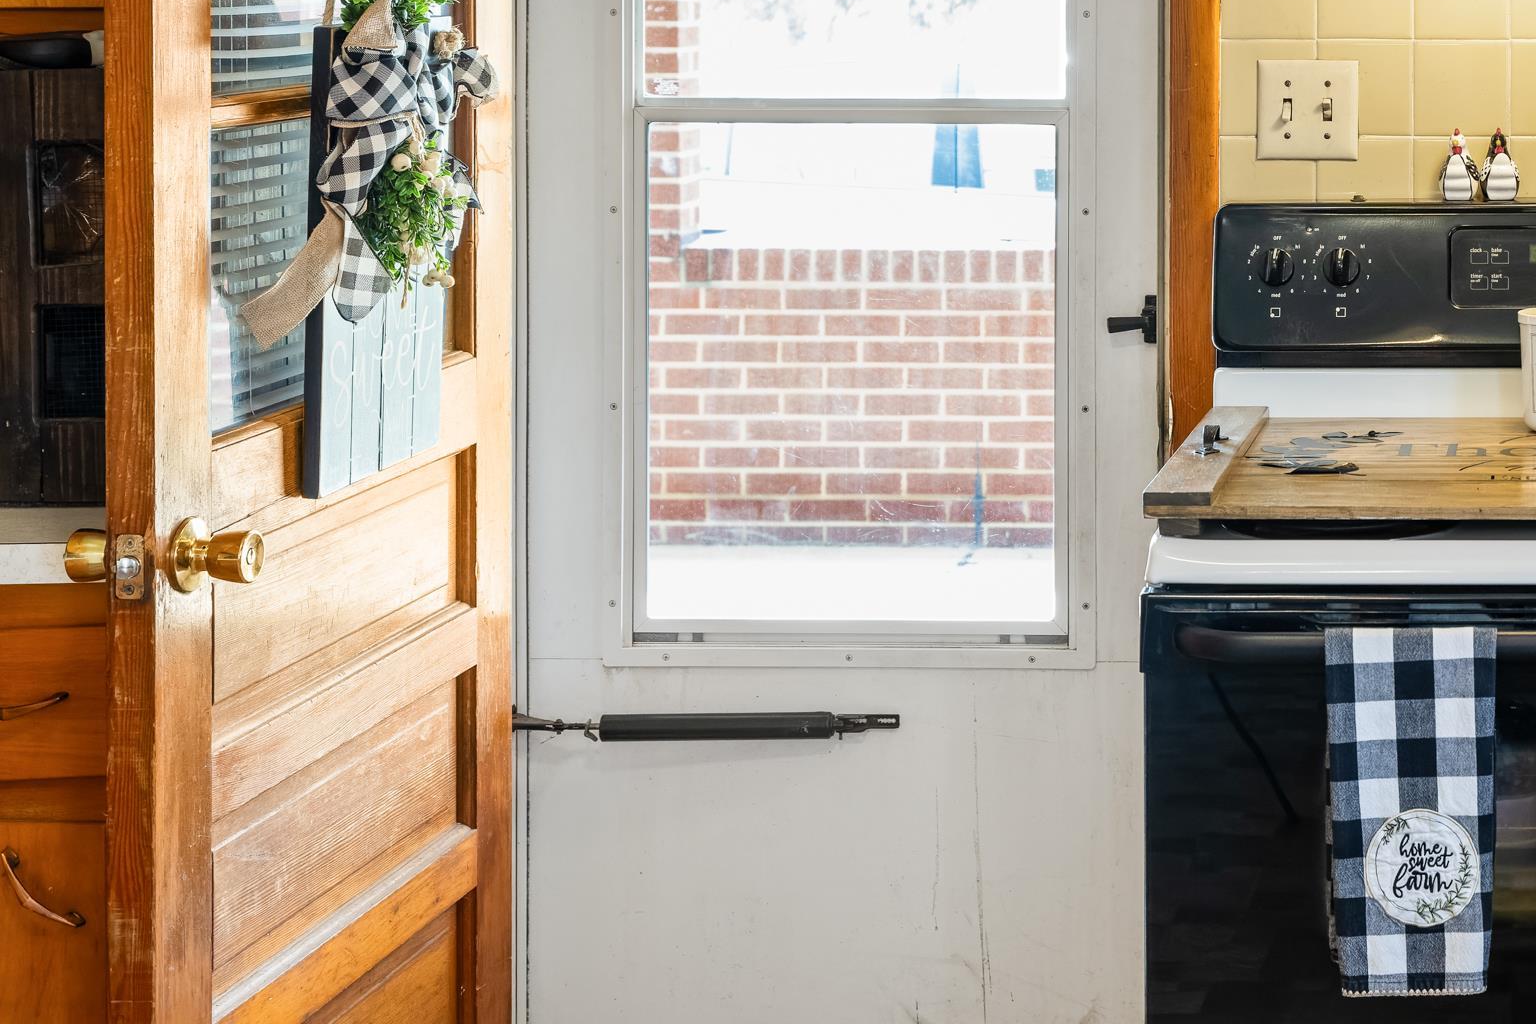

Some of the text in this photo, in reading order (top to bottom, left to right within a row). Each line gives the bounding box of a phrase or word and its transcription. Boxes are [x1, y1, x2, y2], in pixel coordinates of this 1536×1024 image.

[1399, 833, 1443, 857] home
[1408, 846, 1454, 872] sweet
[1393, 863, 1454, 898] farm
